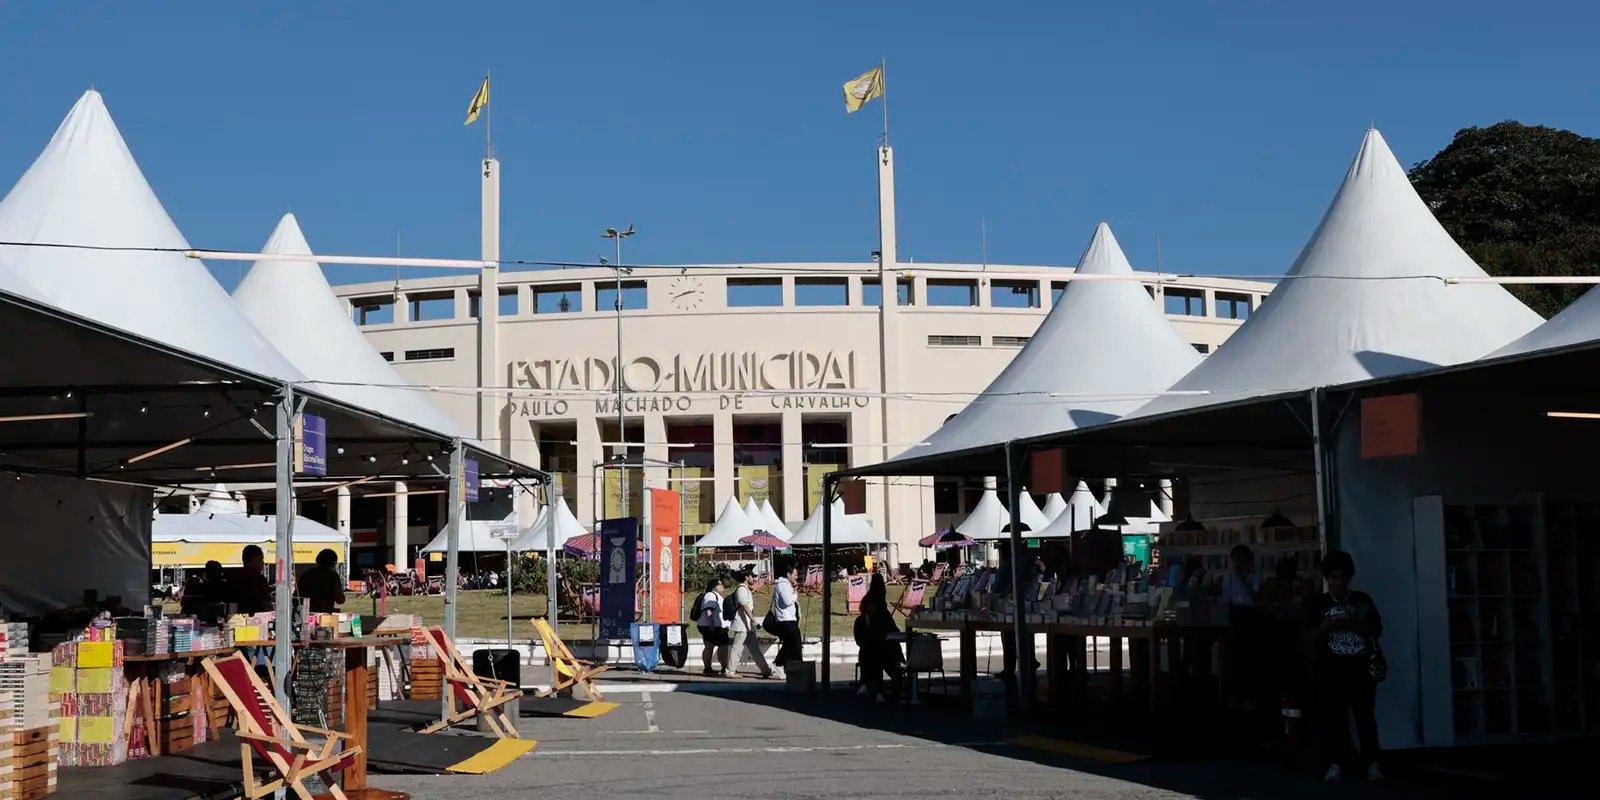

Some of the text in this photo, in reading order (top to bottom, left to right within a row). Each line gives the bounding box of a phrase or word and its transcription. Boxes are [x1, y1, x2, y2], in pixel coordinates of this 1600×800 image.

[508, 394, 870, 416] PAULO MACHADO DE CARVALHO
